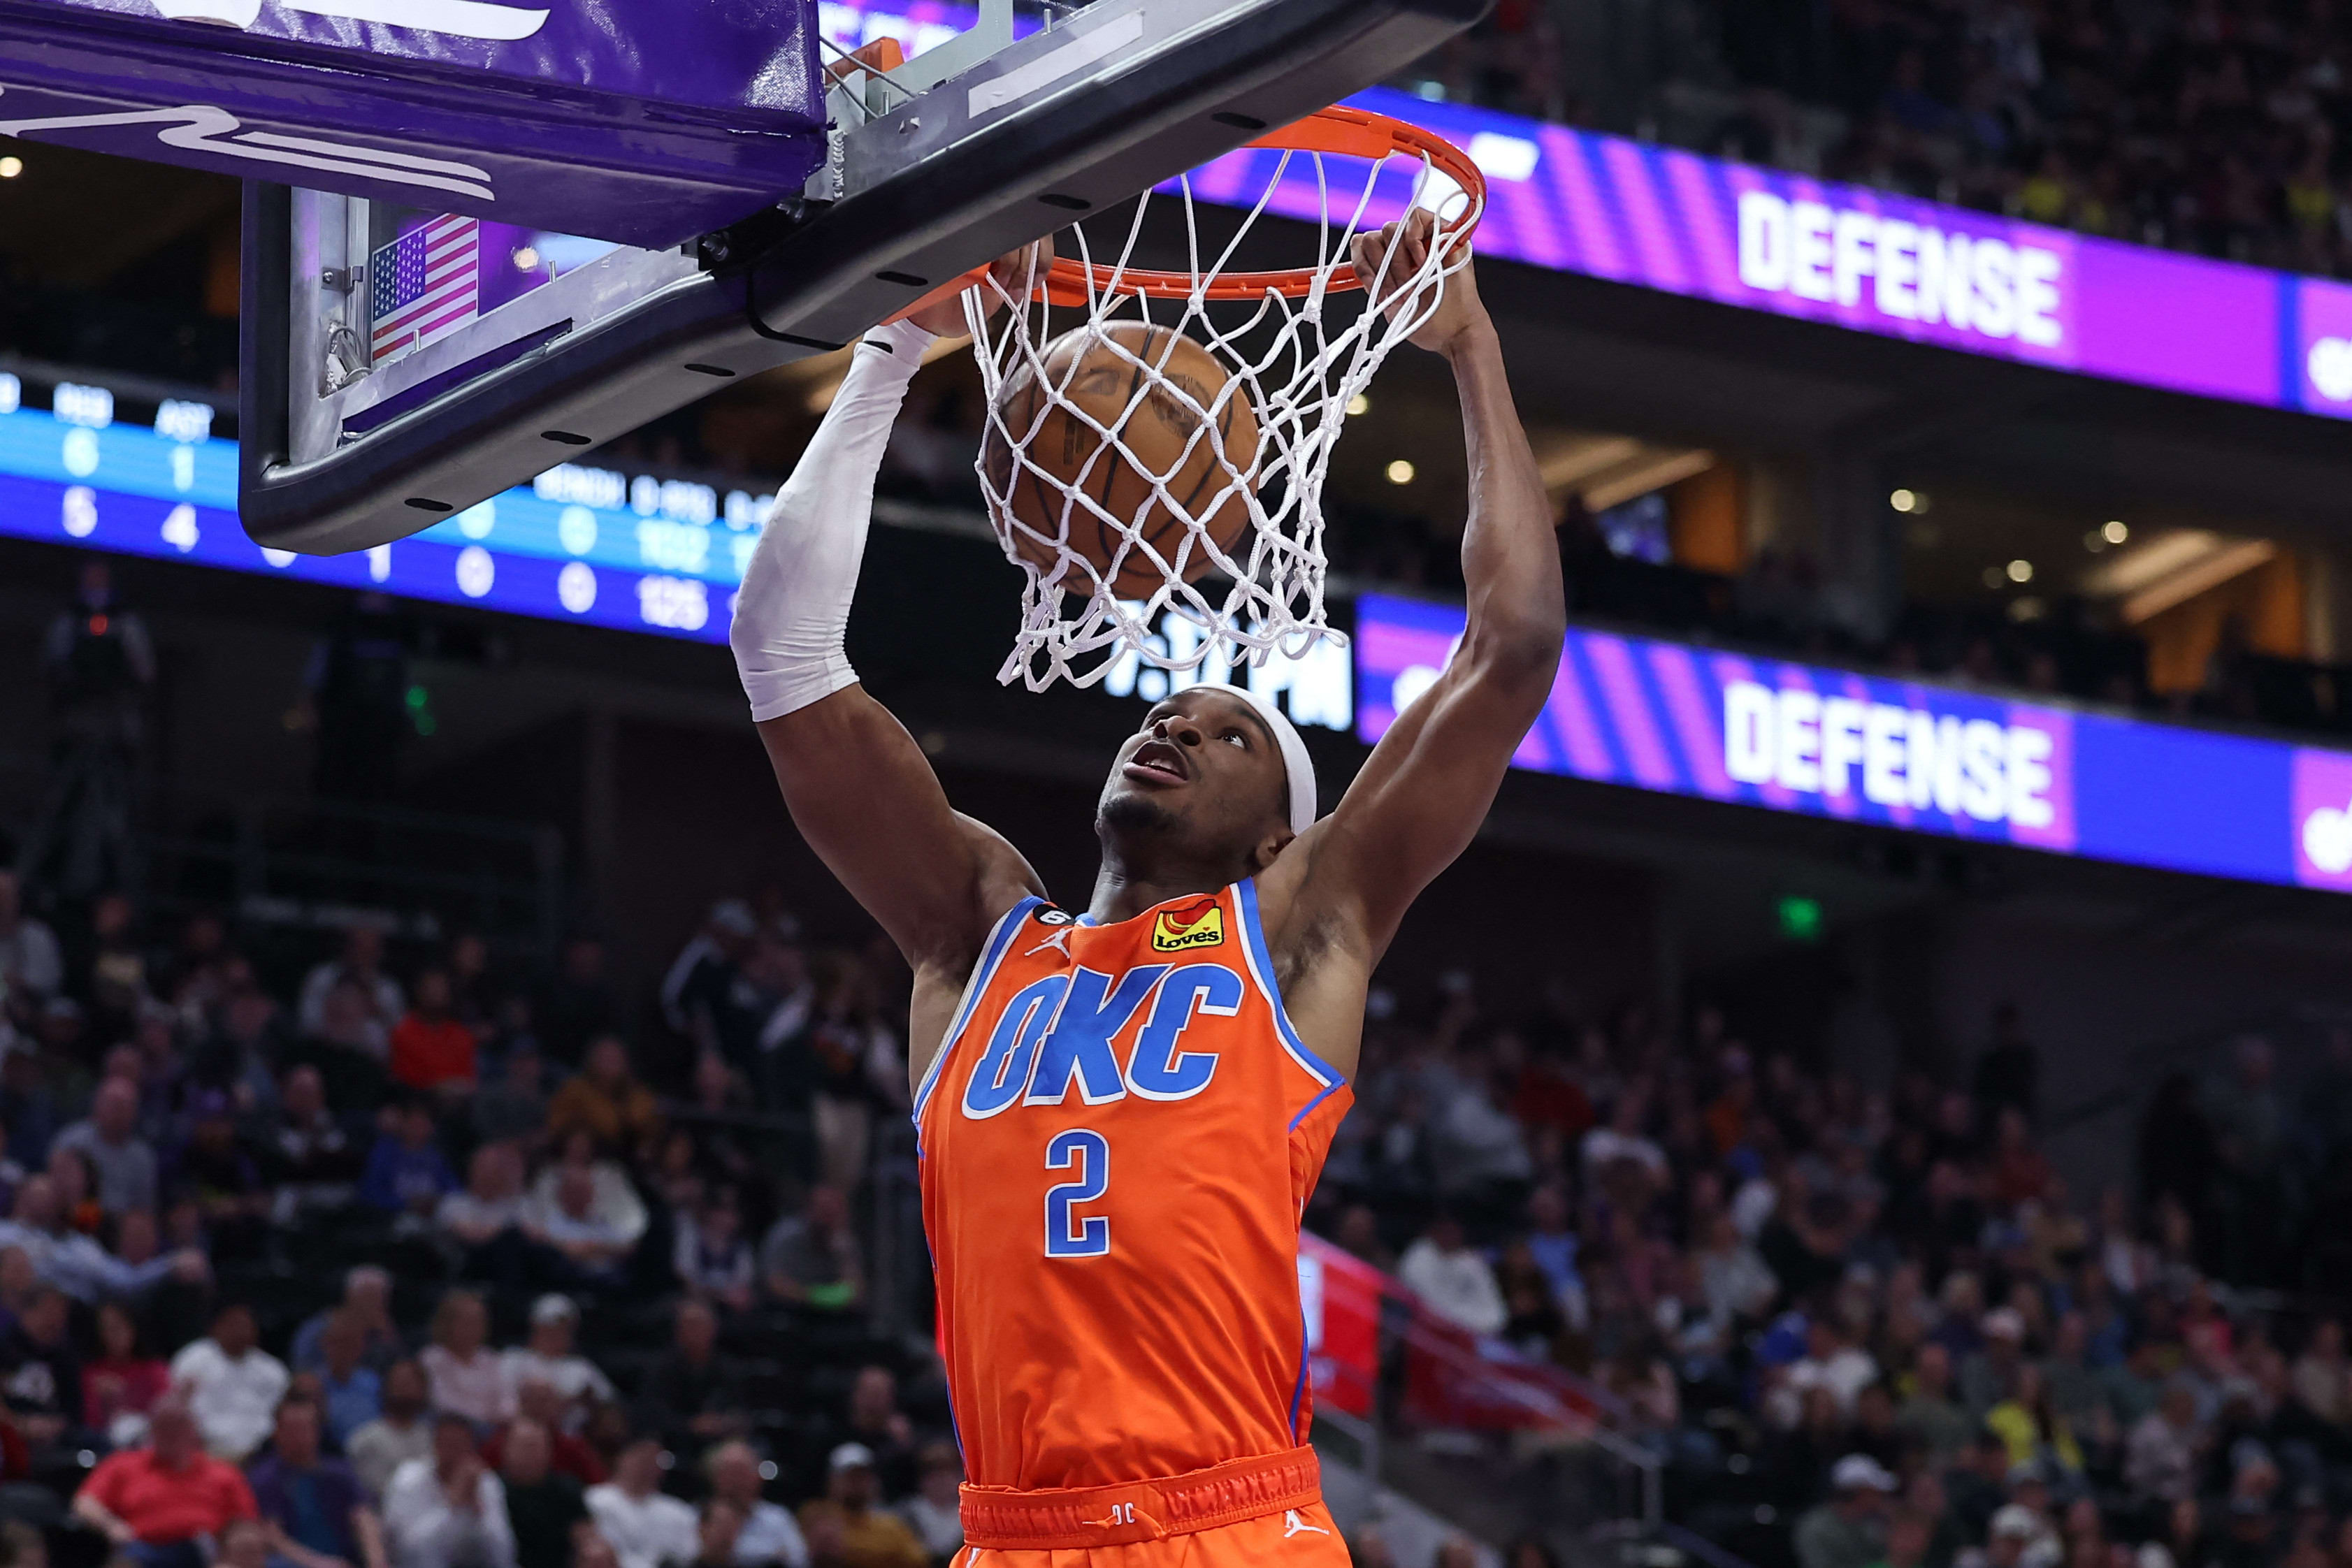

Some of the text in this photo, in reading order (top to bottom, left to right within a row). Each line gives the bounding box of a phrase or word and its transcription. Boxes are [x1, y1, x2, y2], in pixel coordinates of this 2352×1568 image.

[1738, 189, 2063, 348] DEFENSE
[1724, 679, 2055, 829] DEFENSE
[1039, 908, 1072, 925] 6
[961, 962, 1246, 1120] OKC
[1044, 1128, 1110, 1258] 2
